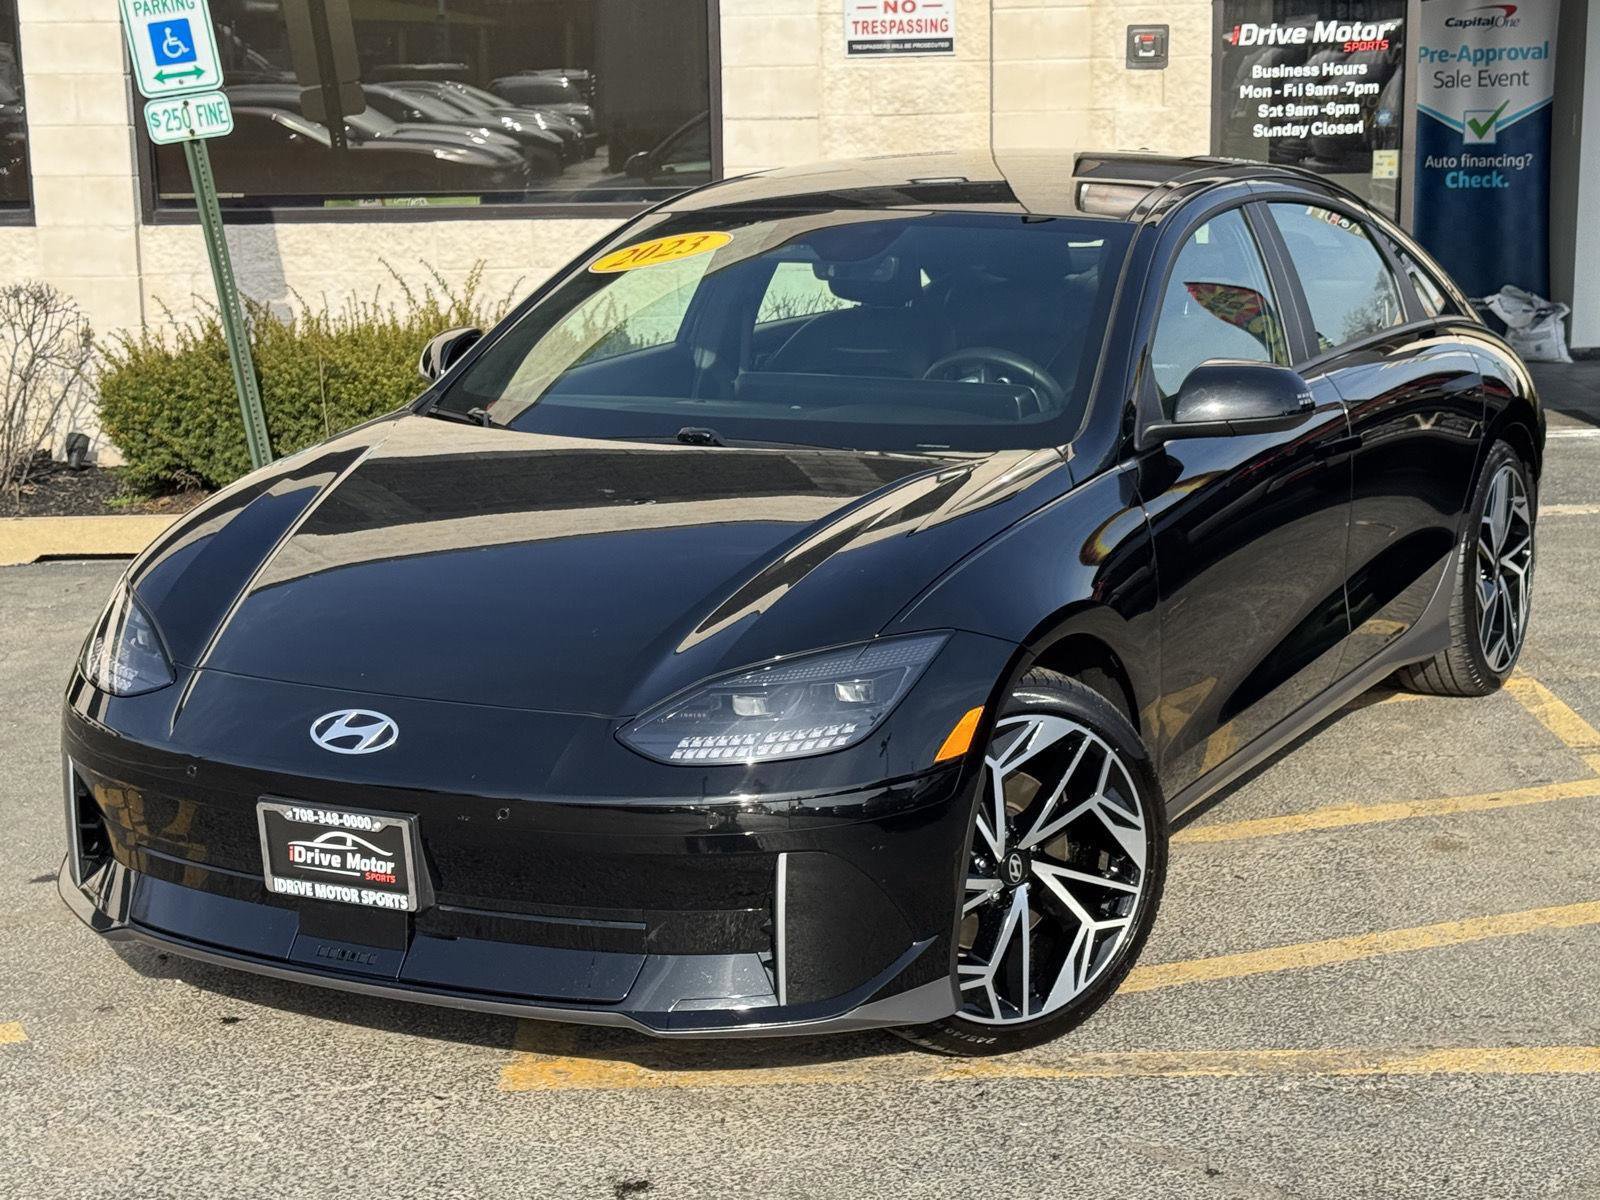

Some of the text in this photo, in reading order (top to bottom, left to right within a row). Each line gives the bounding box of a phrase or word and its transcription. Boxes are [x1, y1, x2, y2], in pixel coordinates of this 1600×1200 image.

[134, 0, 195, 17] PARKING
[883, 0, 917, 14] NO
[852, 18, 949, 35] TRESPASSING
[1231, 20, 1394, 46] iDrive Motor
[1343, 40, 1390, 53] SPORTS
[1418, 41, 1549, 67] Pre-Approval
[1252, 62, 1368, 79] Business Hours
[1433, 69, 1530, 89] Sale Event
[1240, 85, 1272, 99] Mon
[1305, 83, 1339, 97] 9am
[150, 101, 230, 132] $250 FINE
[1258, 104, 1284, 118] Sat
[1285, 103, 1319, 117] 9am
[1253, 120, 1364, 139] Sunday Closed
[1425, 153, 1534, 171] Auto financing?
[1445, 170, 1510, 189] Check.
[605, 235, 710, 268] 2023
[292, 808, 372, 830] 708-348-0000
[288, 846, 395, 875] iDrive Motor
[365, 872, 396, 883] SPORTS
[273, 877, 409, 910] IDRIVE MOTOR SPORTS
